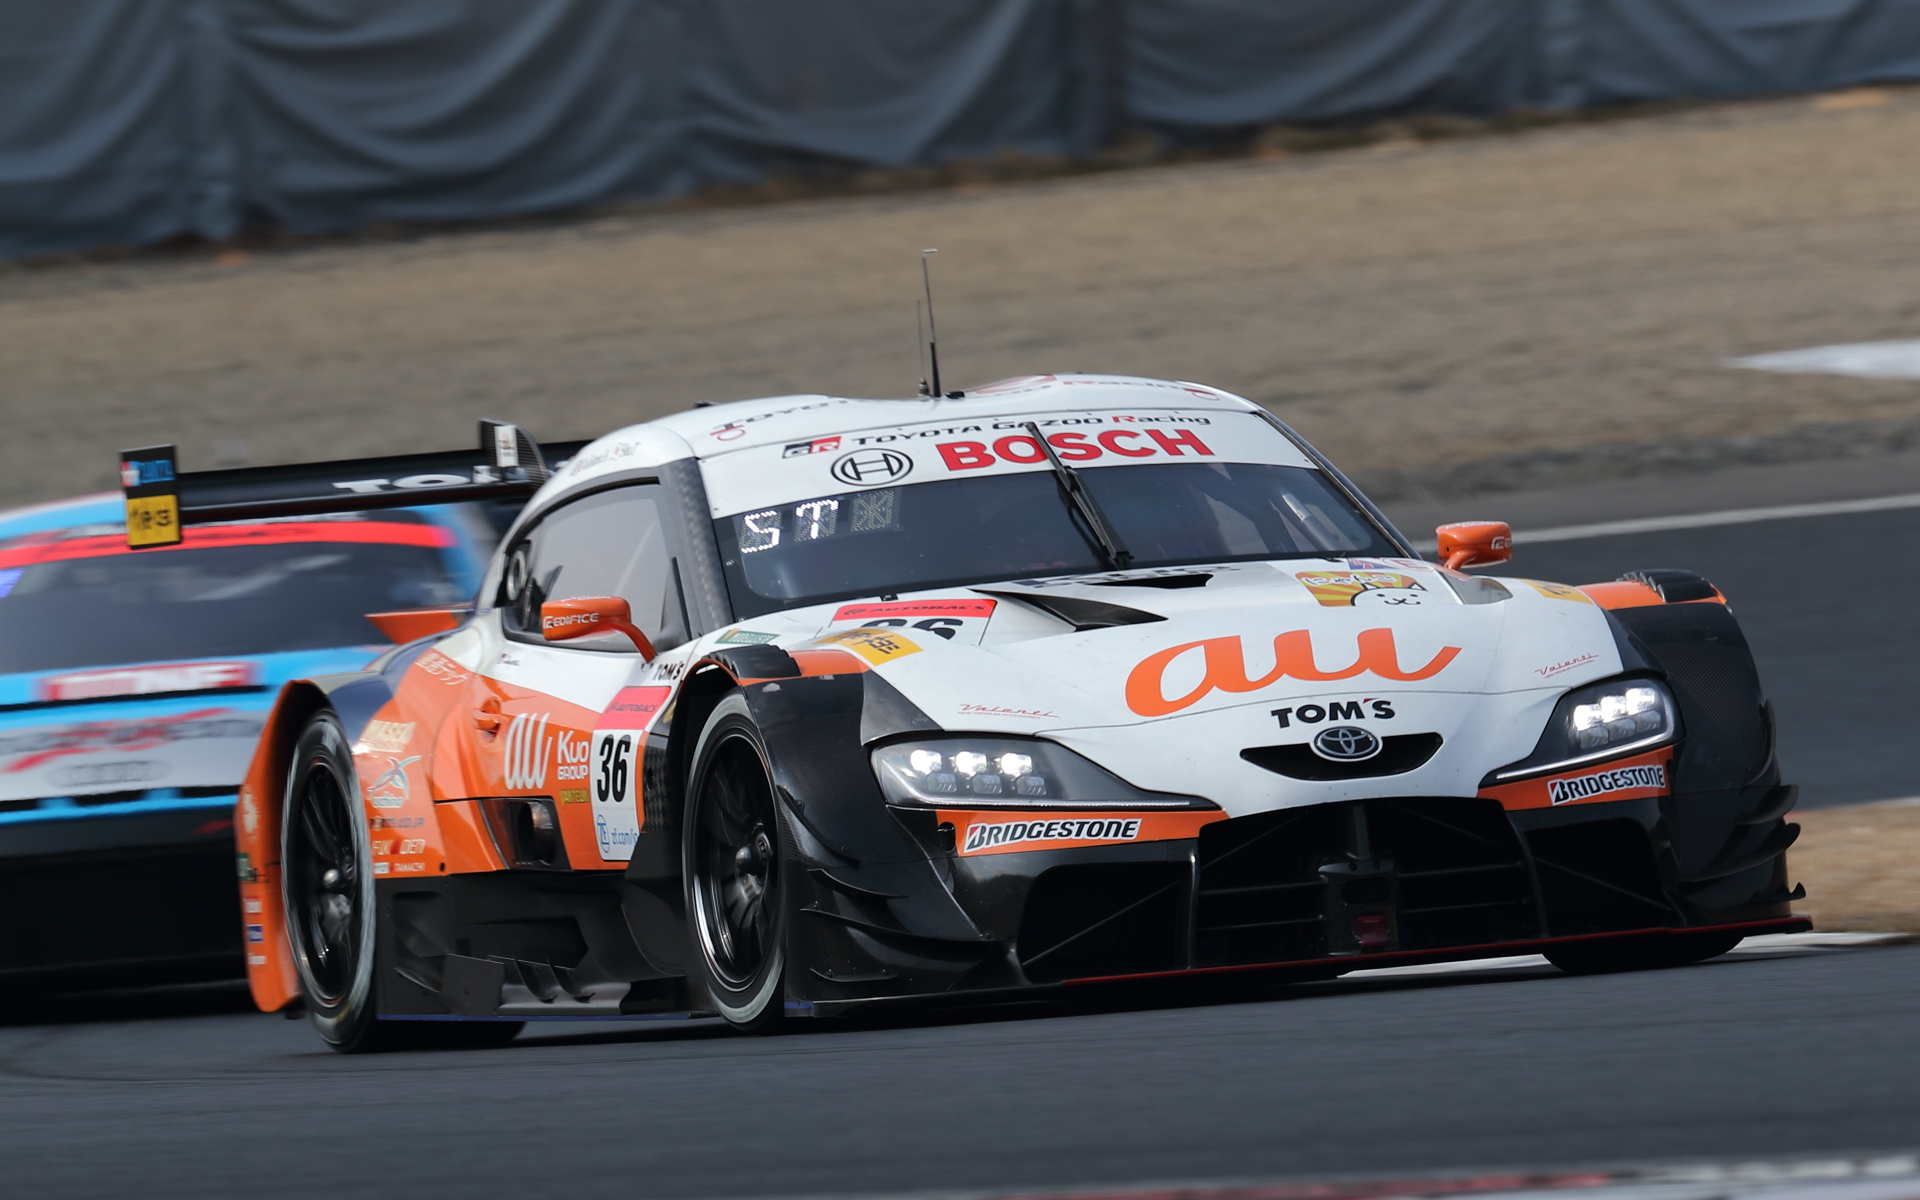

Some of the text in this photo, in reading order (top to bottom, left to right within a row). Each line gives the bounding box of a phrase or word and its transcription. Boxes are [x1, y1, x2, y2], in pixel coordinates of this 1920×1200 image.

[851, 425, 983, 446] TOYOTA
[1111, 413, 1212, 427] Racing
[936, 428, 1216, 472] BOSCH
[553, 612, 600, 629] EDIFICE
[1125, 627, 1463, 718] au
[1271, 697, 1397, 729] TOM'S
[557, 730, 590, 764] Kuo
[557, 765, 589, 781] GROUP
[597, 733, 632, 803] 36
[1549, 765, 1665, 804] BRIDGESTONE
[966, 820, 1139, 851] BRIDGESTONE
